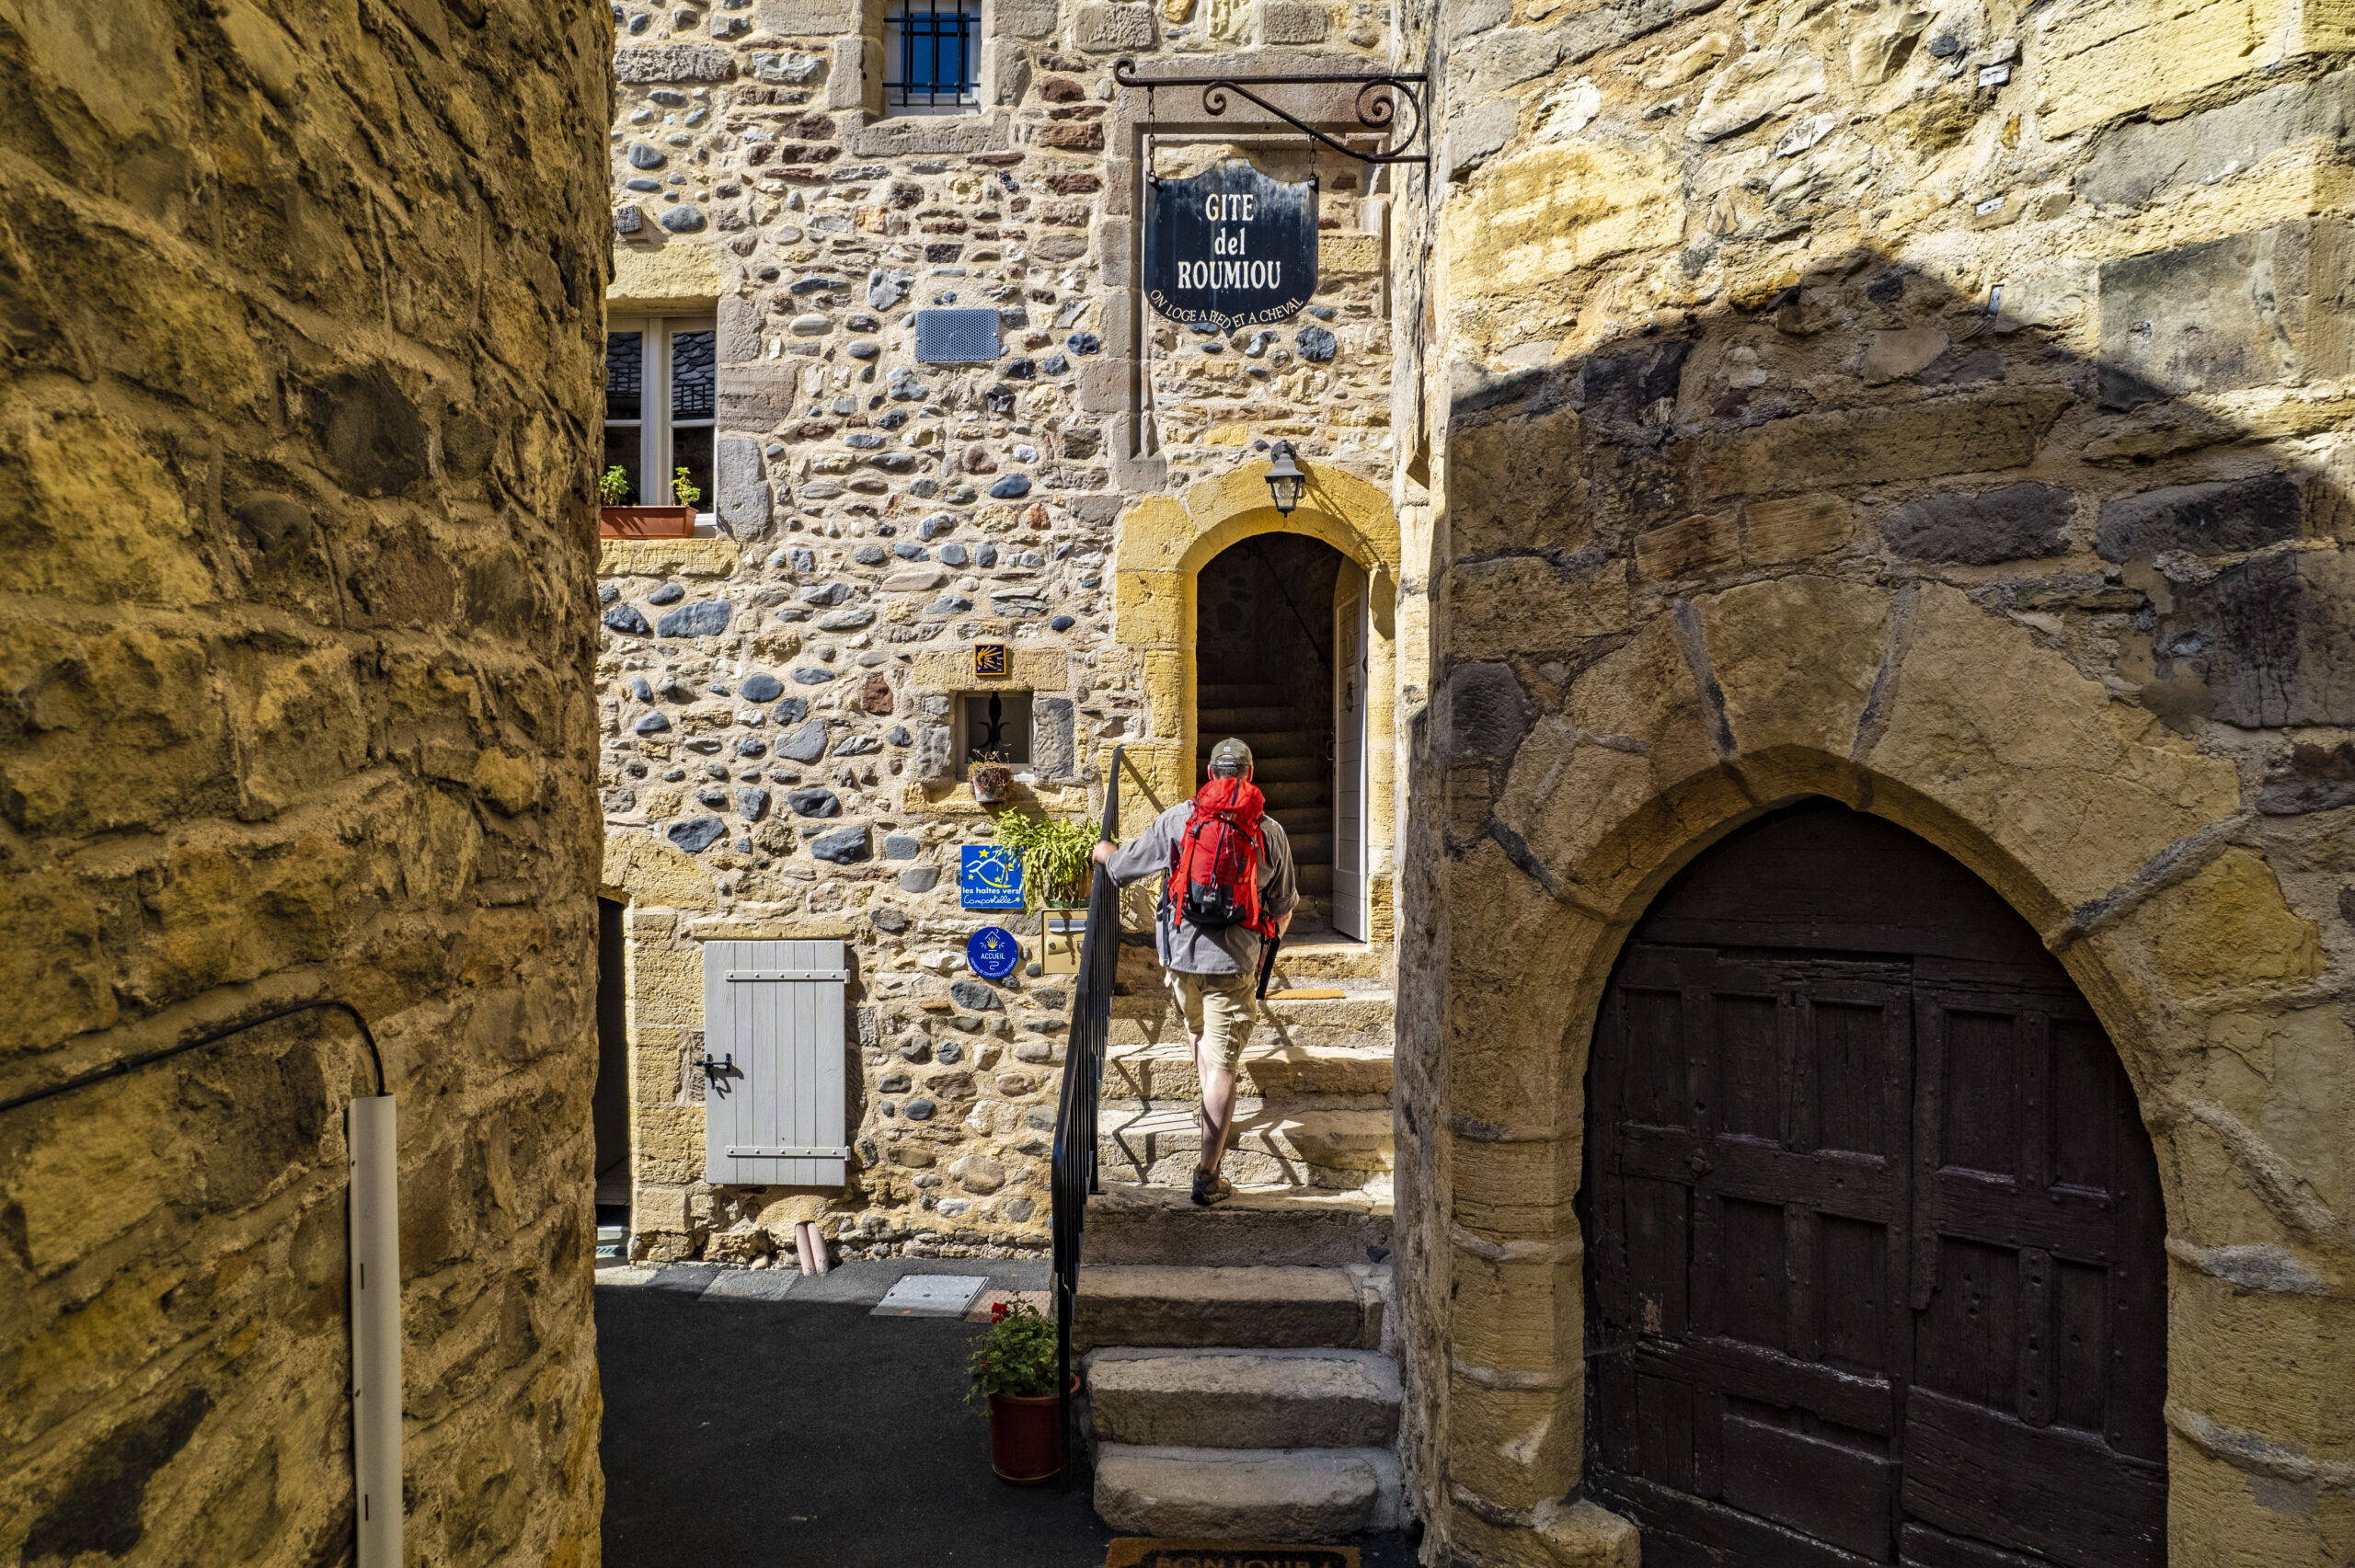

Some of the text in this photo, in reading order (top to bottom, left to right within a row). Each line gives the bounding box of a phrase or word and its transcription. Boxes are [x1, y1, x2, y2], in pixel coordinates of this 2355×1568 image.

[1205, 193, 1255, 222] GITE
[1214, 227, 1246, 255] del
[1178, 260, 1281, 290] ROUMIOU
[1150, 290, 1304, 329] ON LOGE A PIED ET A CHEVAL
[964, 895, 1013, 907] Compostelle
[981, 952, 1005, 960] ACCUEIL
